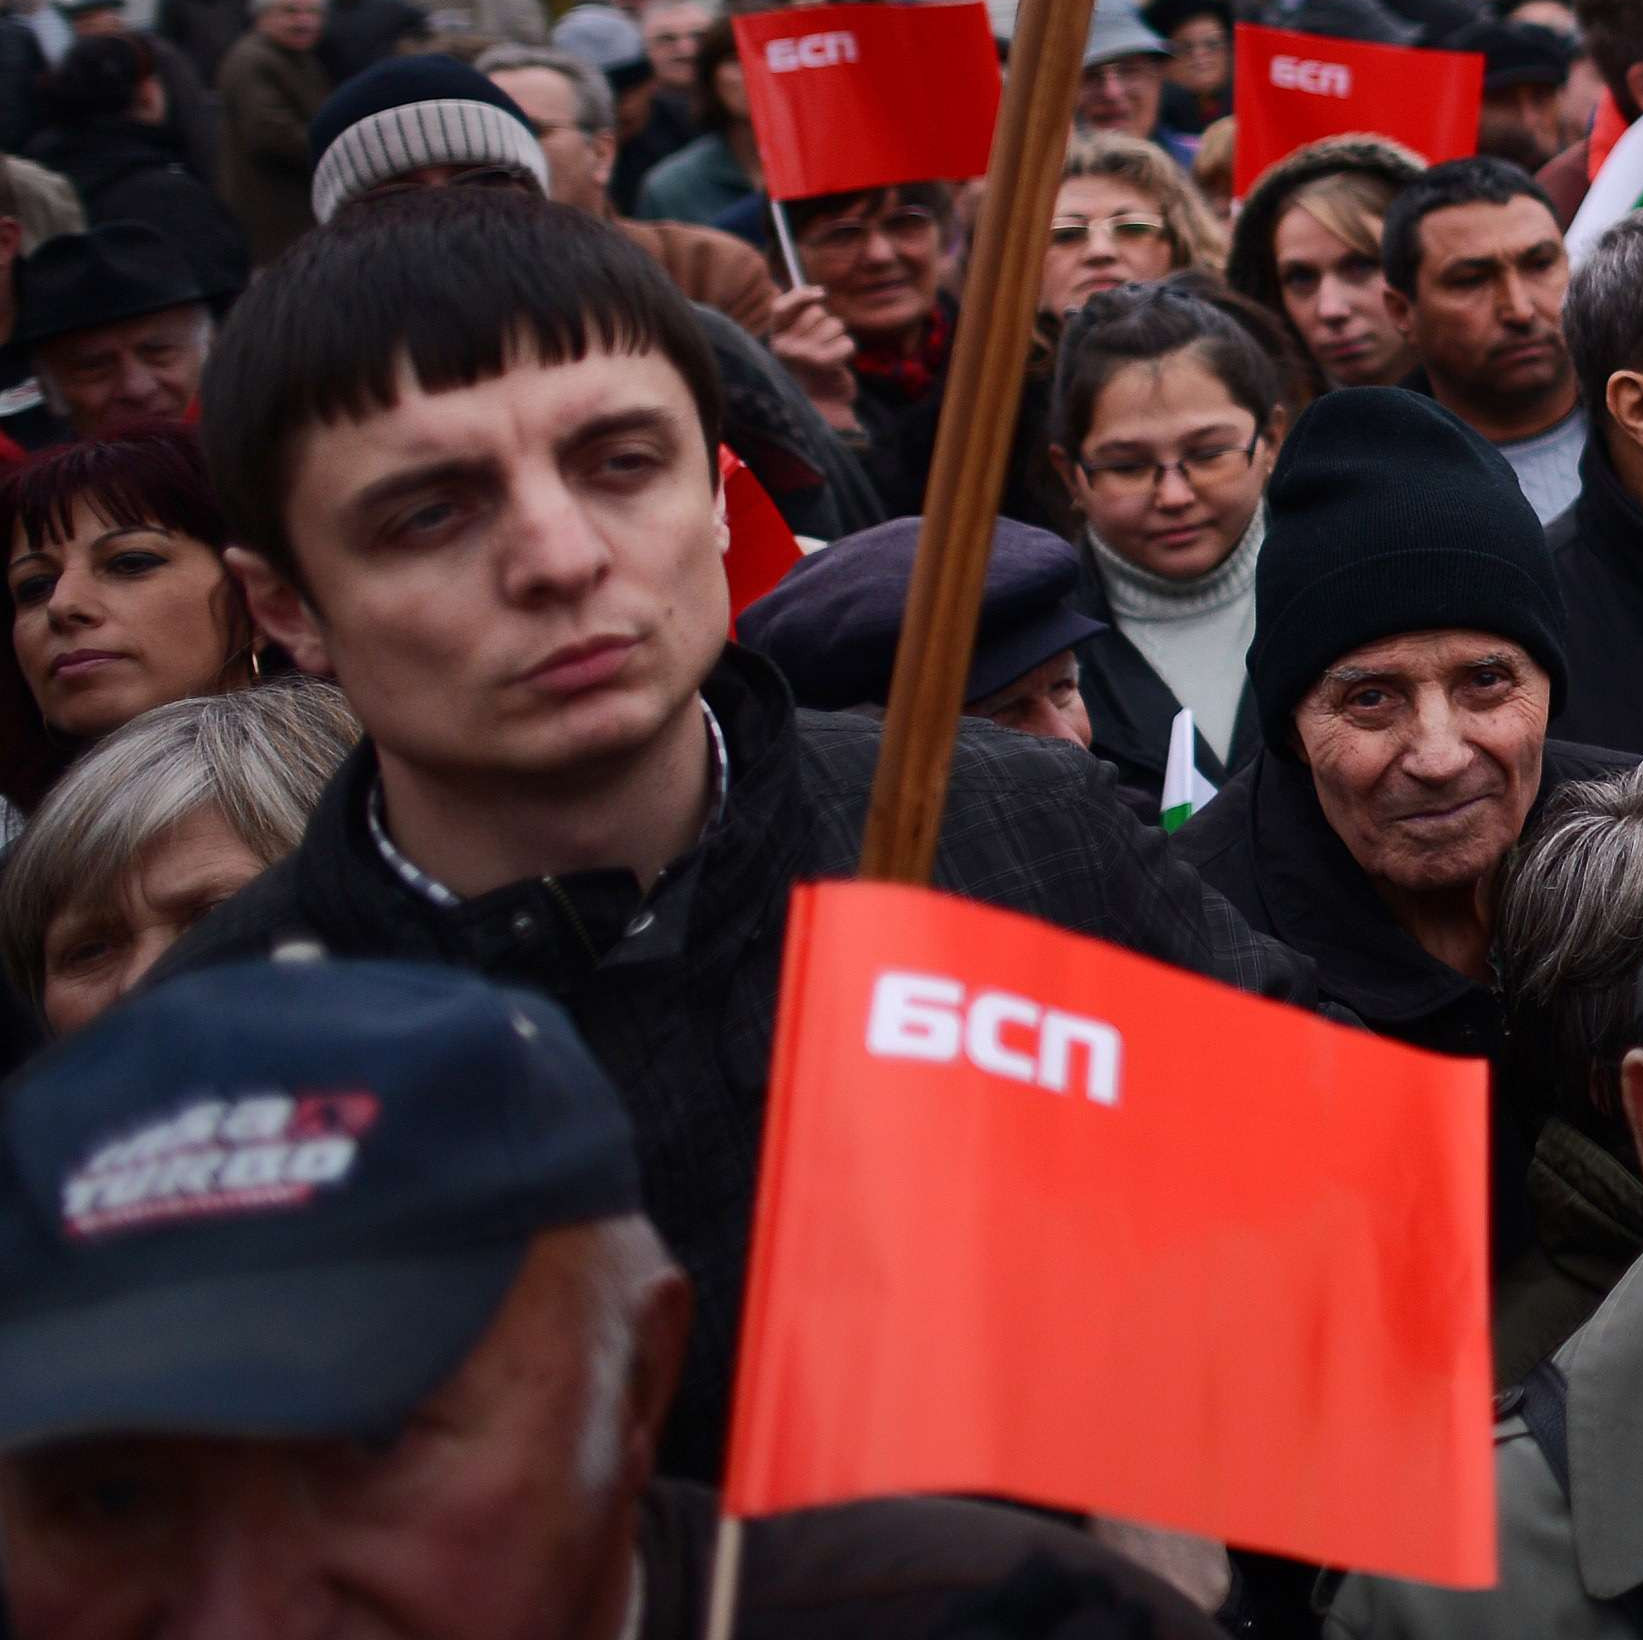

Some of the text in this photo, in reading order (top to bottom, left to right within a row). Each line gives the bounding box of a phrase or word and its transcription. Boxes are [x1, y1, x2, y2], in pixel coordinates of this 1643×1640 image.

[765, 30, 860, 74] БСП
[1269, 55, 1352, 100] БСП
[865, 971, 1124, 1108] БСП
